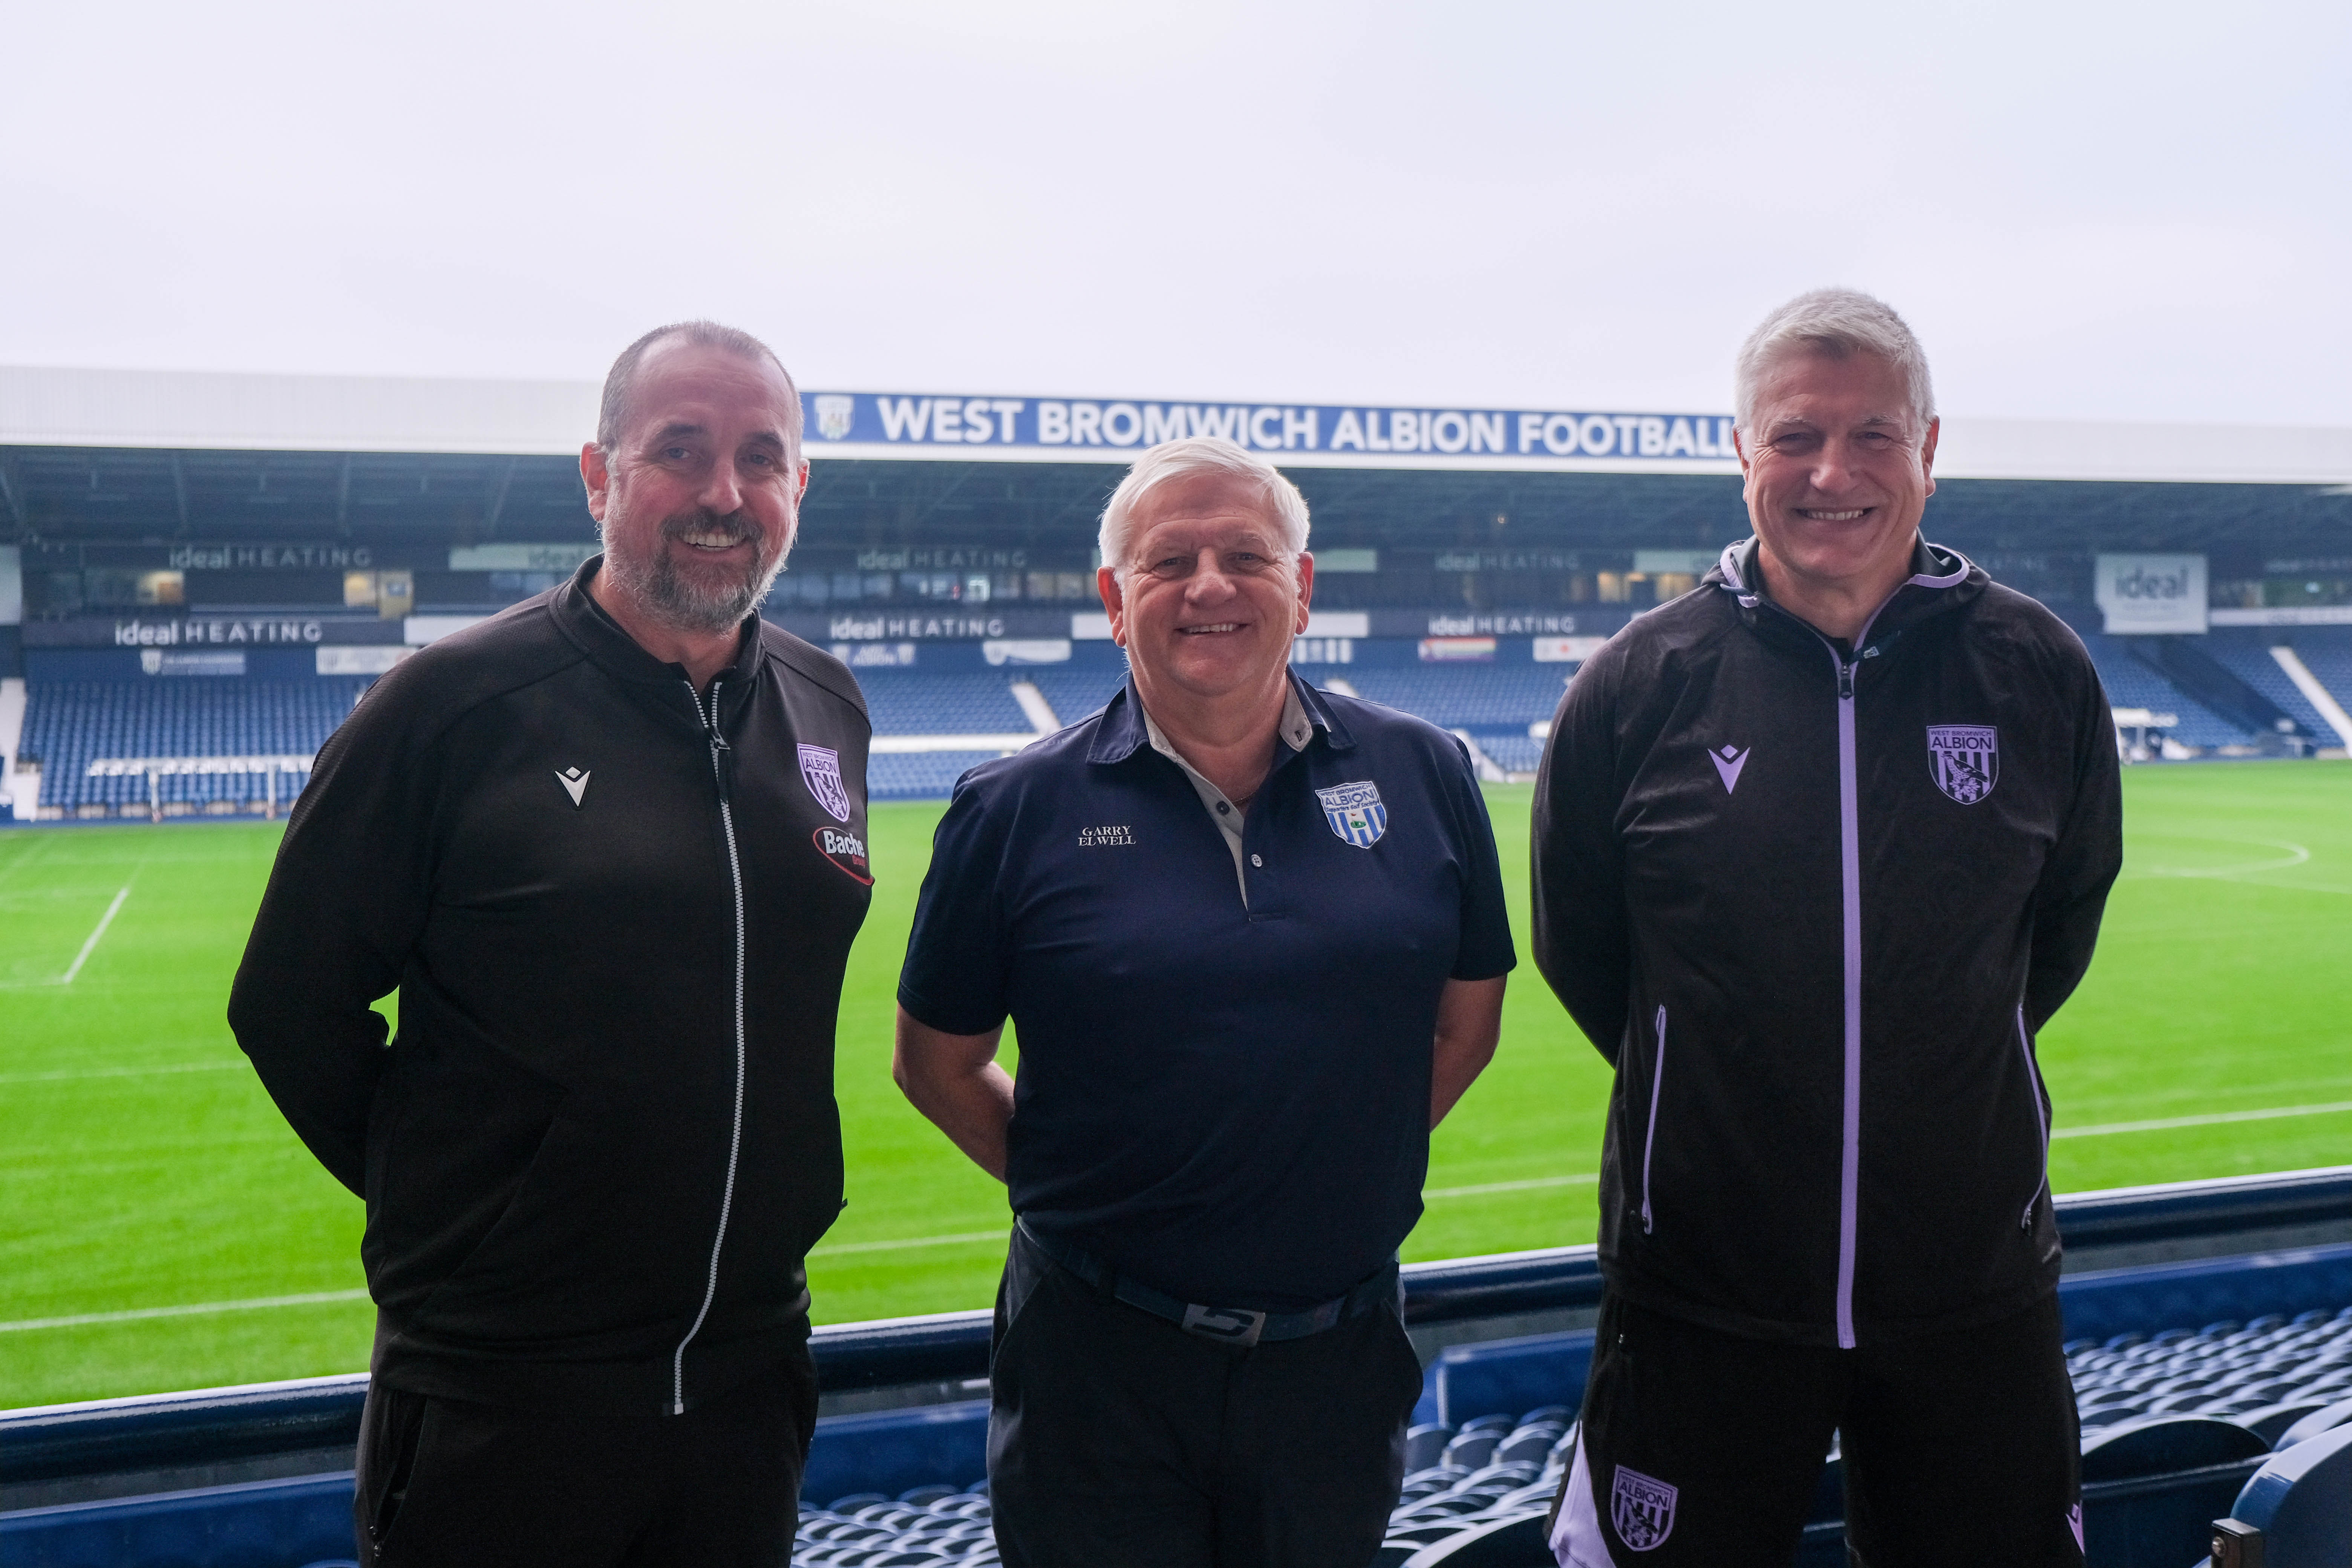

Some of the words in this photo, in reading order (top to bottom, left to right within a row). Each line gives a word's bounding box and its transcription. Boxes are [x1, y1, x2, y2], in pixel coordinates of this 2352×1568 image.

[876, 397, 1024, 444] WEST
[1037, 401, 1318, 449] BROMWICH
[1329, 409, 1505, 452] ALBION
[1517, 414, 1735, 457] FOOTBALL
[169, 543, 231, 569] ideal
[237, 547, 374, 567] HEATING
[857, 547, 910, 570] ideal
[915, 550, 1026, 568] HEATING
[2115, 565, 2188, 600] ideal
[115, 619, 178, 646] ideal
[185, 622, 323, 643] HEATING
[831, 617, 885, 640] ideal
[889, 618, 1004, 637] HEATING
[1428, 614, 1475, 636] ideal
[1477, 616, 1576, 634] HEATING
[1932, 736, 1992, 750] ALBION
[806, 758, 836, 774] ALBION
[1325, 789, 1375, 806] ALBION
[1336, 784, 1371, 795] BROMWICH
[1078, 835, 1136, 846] ELWELL
[1082, 825, 1131, 836] GARRY
[823, 830, 865, 858] Bache
[1620, 1481, 1668, 1507] ALBION
